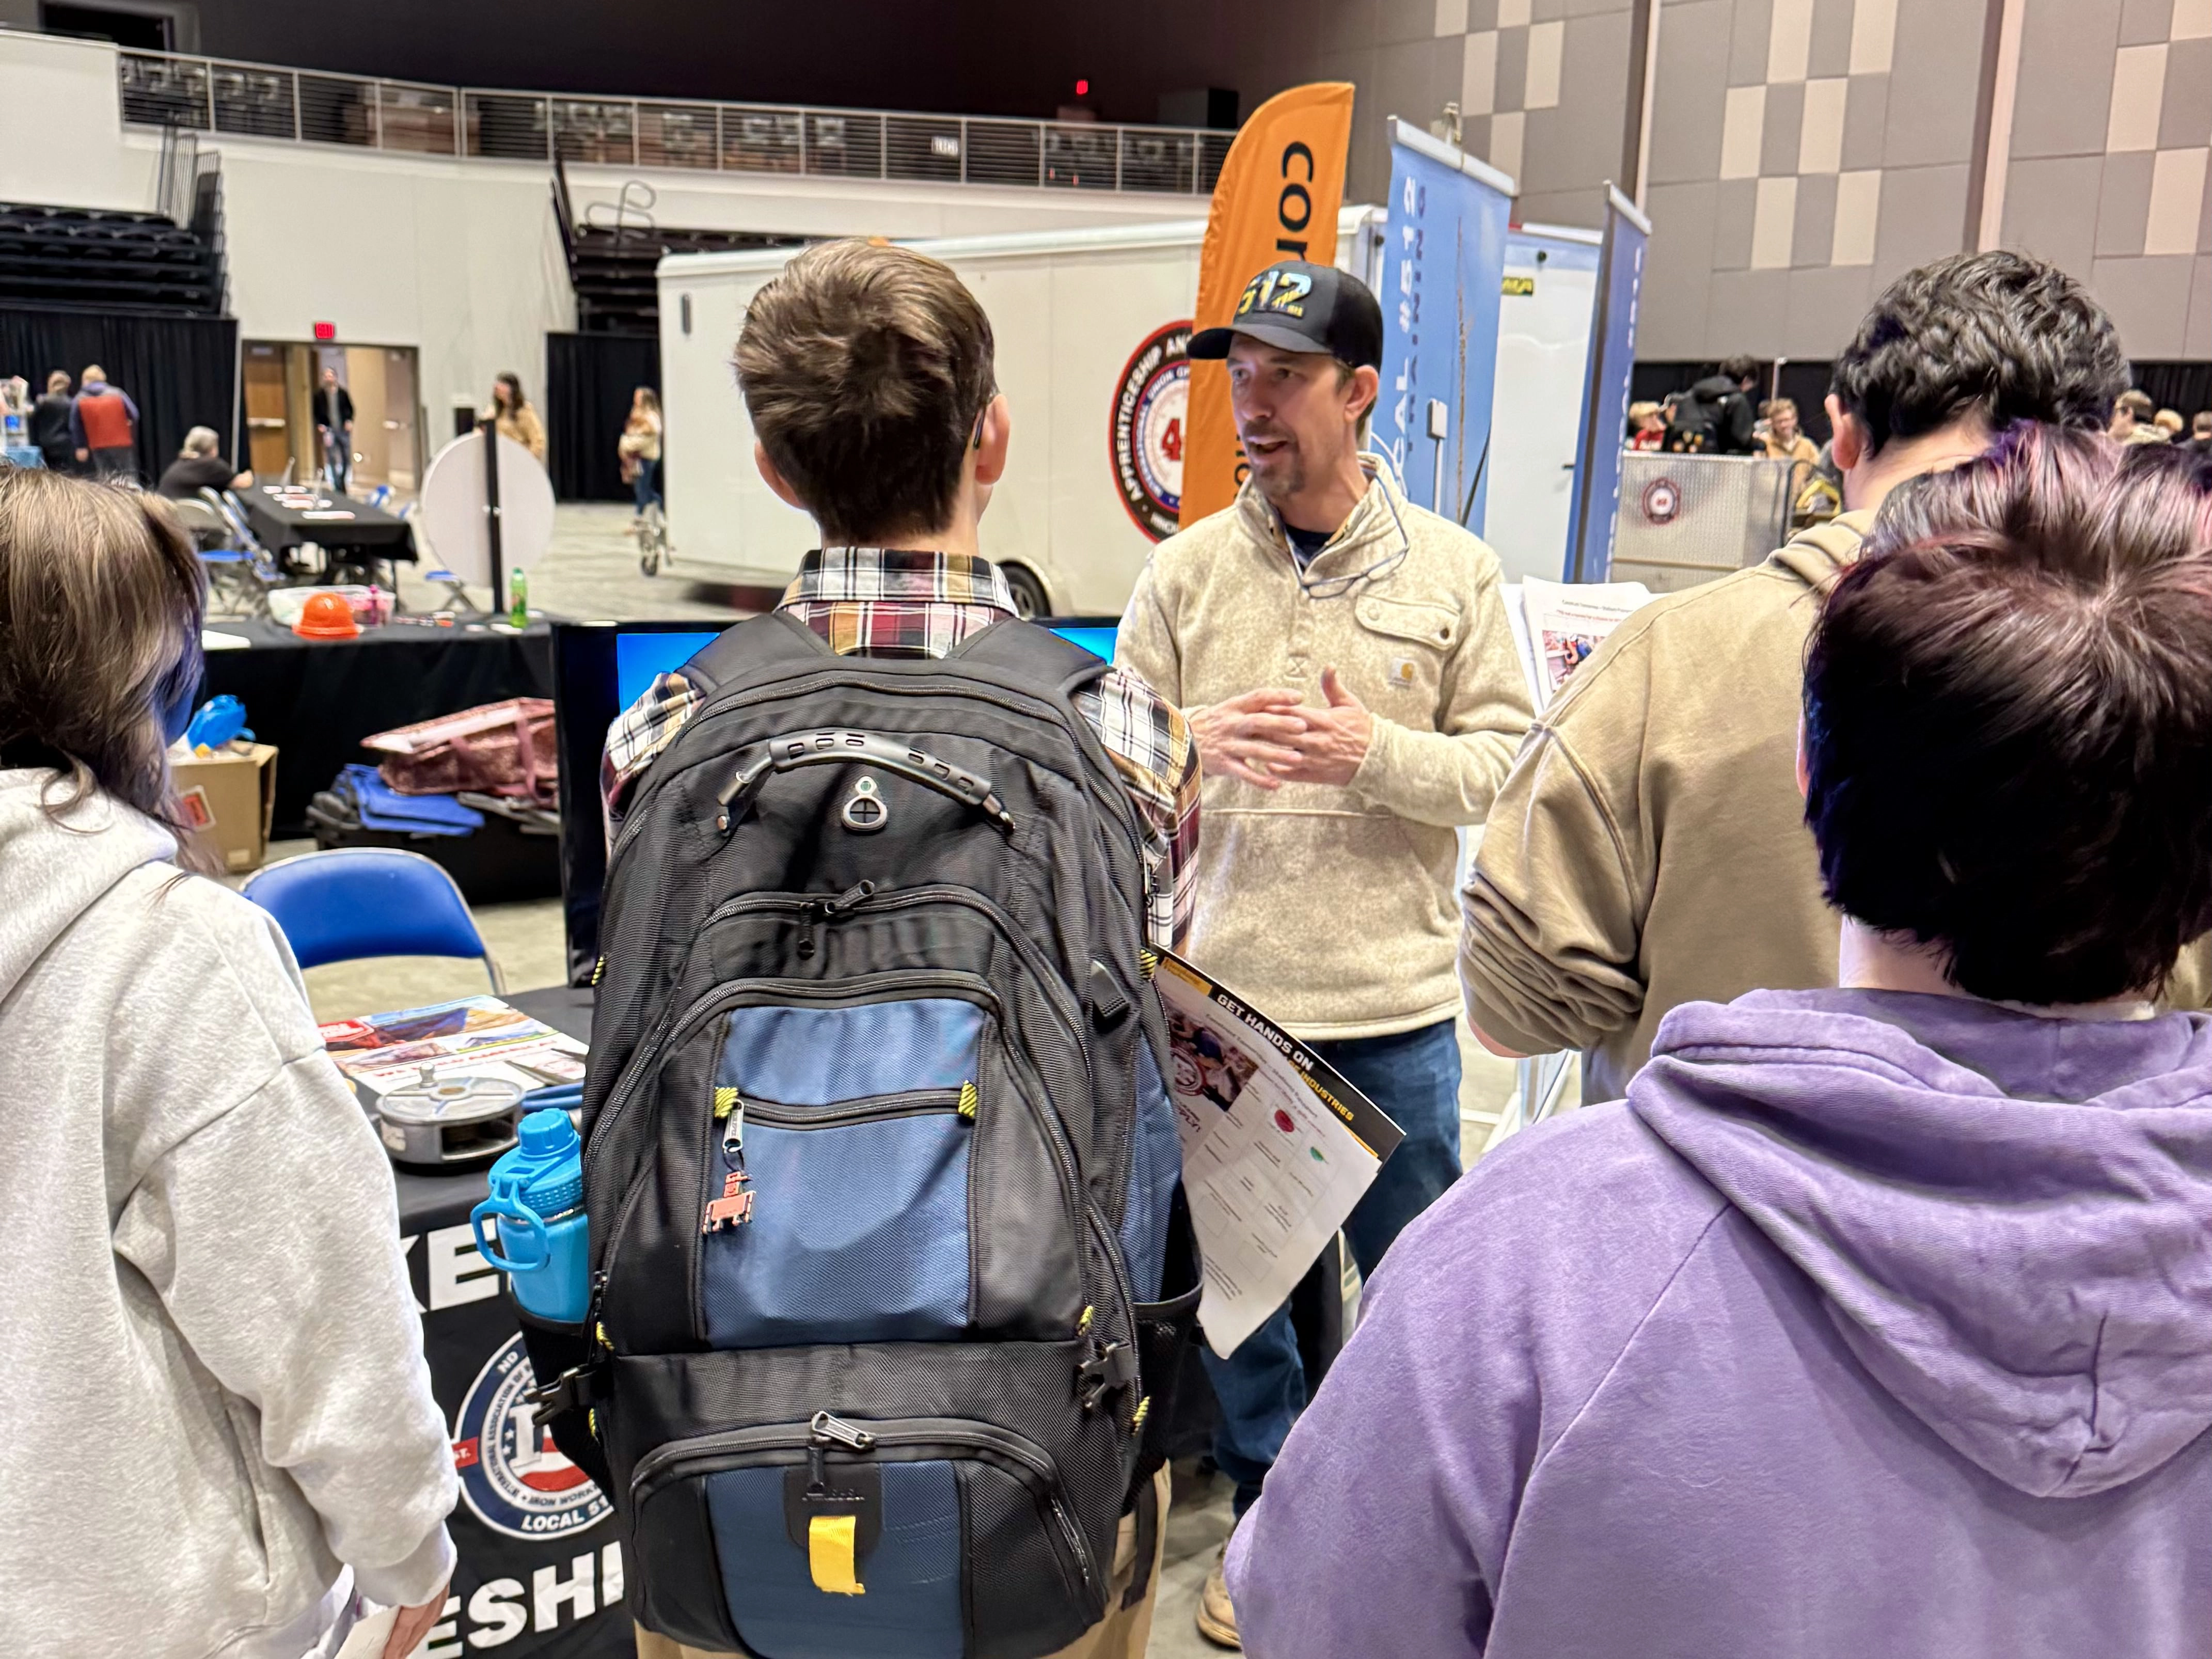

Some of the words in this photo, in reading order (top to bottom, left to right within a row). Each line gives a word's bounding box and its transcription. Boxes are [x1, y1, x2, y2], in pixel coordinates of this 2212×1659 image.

[1117, 345, 1162, 501] APPRENTICESHIP
[1166, 334, 1192, 357] AN
[1217, 994, 1245, 1019] GET
[1244, 1014, 1292, 1054] HANDS
[1293, 1050, 1314, 1071] ON
[1301, 1071, 1354, 1121] INDUSTRIES
[520, 1510, 585, 1531] LOCAL
